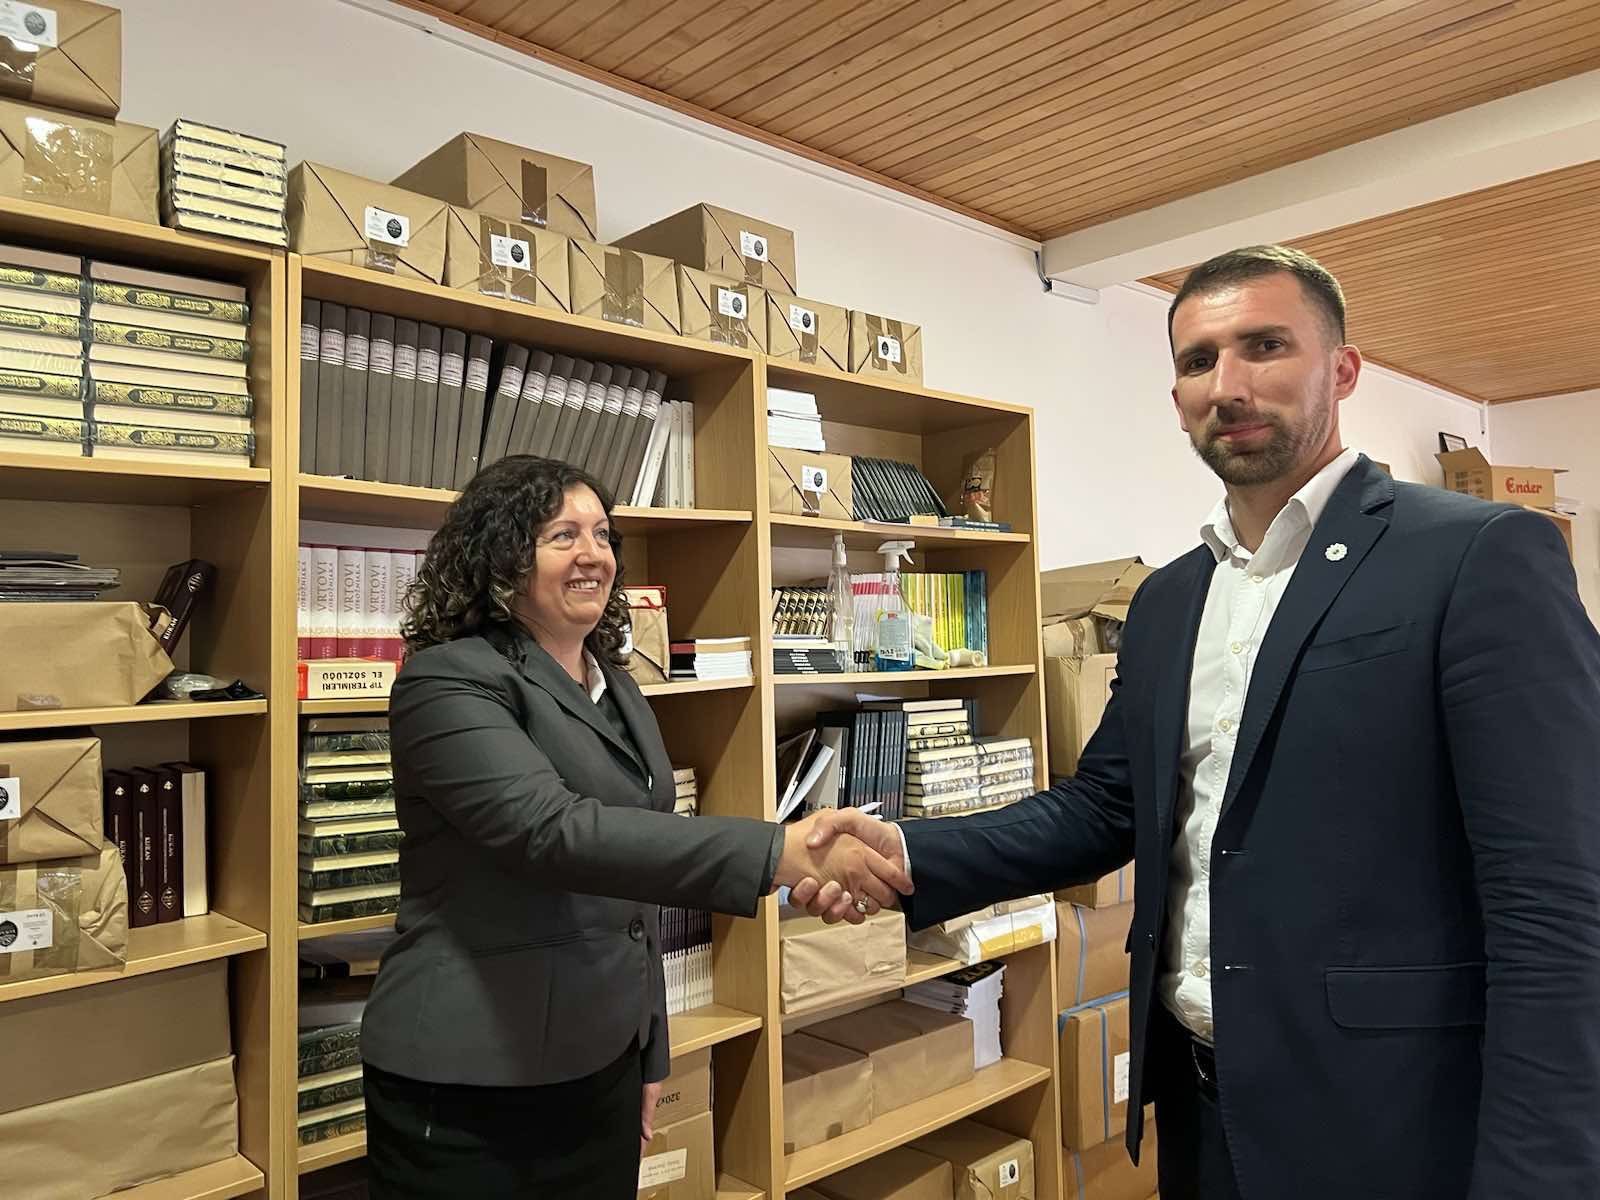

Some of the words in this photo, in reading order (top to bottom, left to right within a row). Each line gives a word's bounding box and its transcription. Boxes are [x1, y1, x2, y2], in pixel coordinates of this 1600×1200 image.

[1506, 477, 1542, 494] Ender
[317, 561, 327, 612] VRTOVI
[343, 563, 354, 613] VRTOVI
[370, 564, 380, 613] VRTOVI
